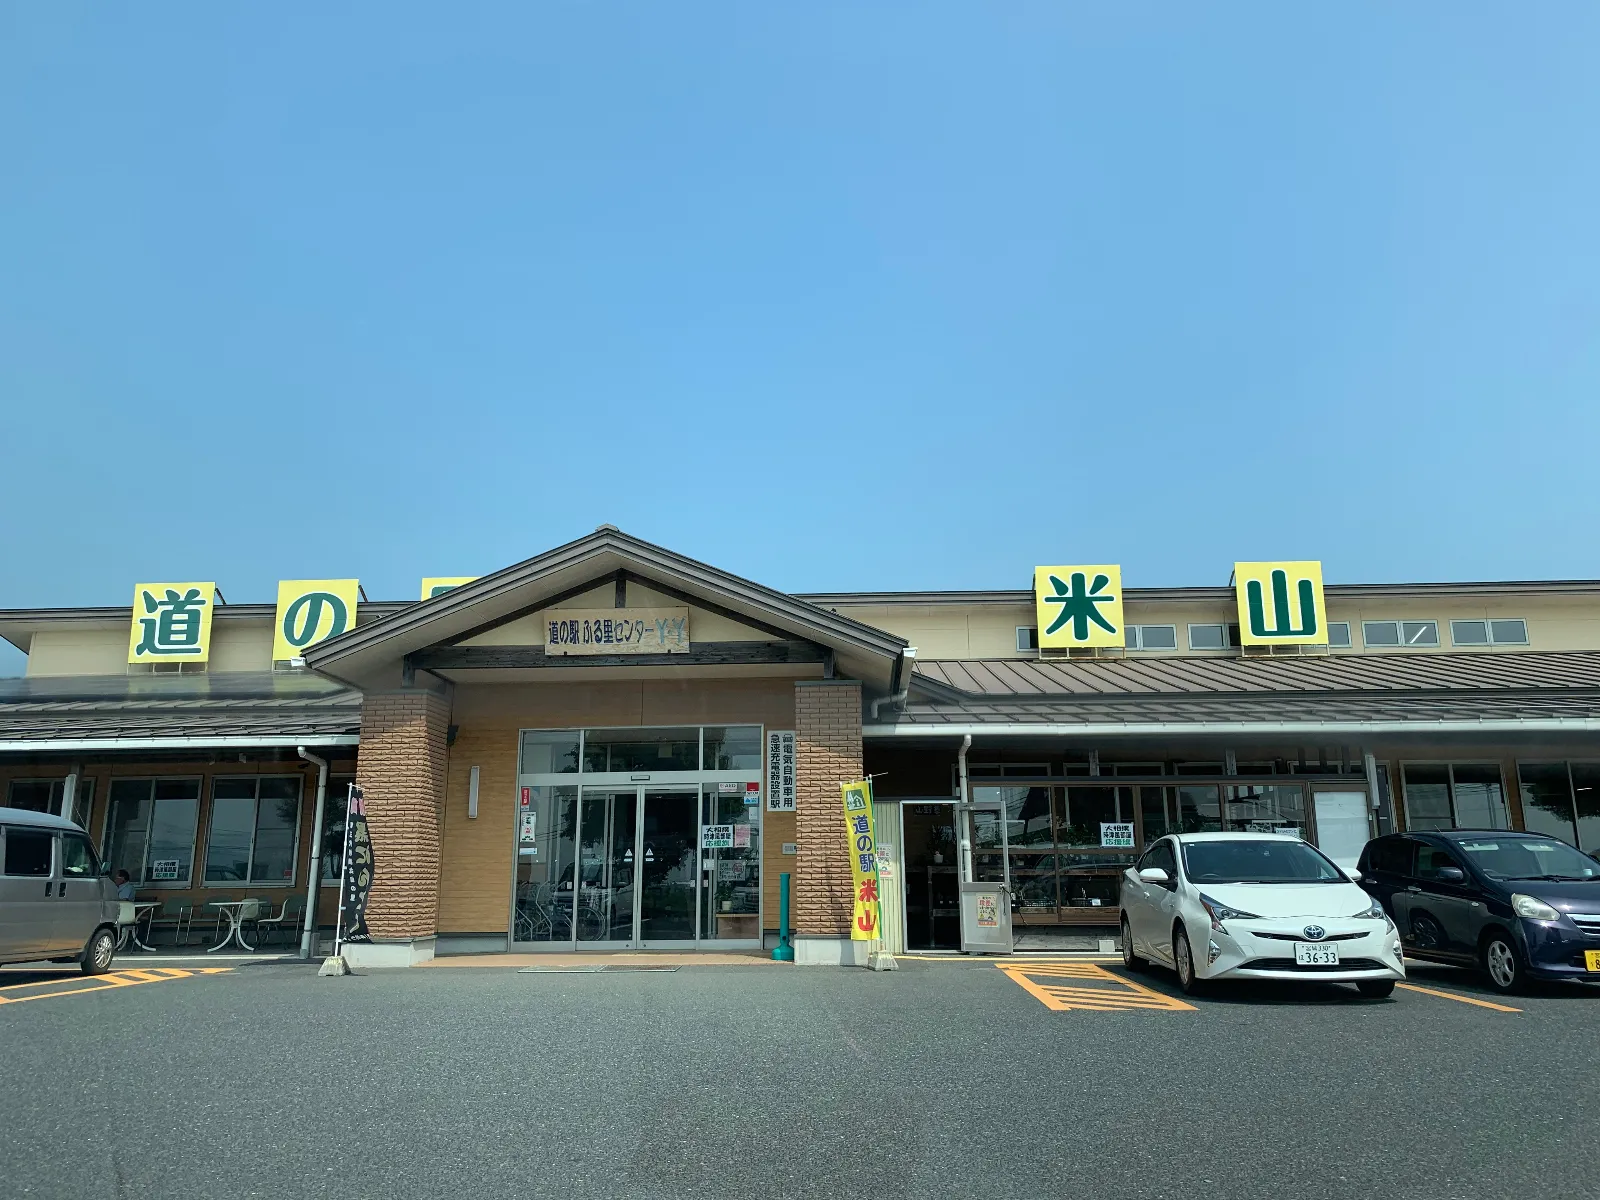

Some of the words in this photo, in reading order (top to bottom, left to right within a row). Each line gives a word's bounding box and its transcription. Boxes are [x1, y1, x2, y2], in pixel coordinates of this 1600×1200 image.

[136, 589, 206, 655] 道
[283, 592, 347, 647] の
[1044, 572, 1116, 640] 米
[1247, 569, 1317, 637] 山
[549, 619, 580, 645] 道の駅
[770, 734, 780, 809] 急速充電器設置駅
[782, 744, 793, 808] 電気自動車用
[851, 814, 876, 872] 道の駅
[857, 878, 879, 932] 米山
[1305, 952, 1336, 963] 36-33
